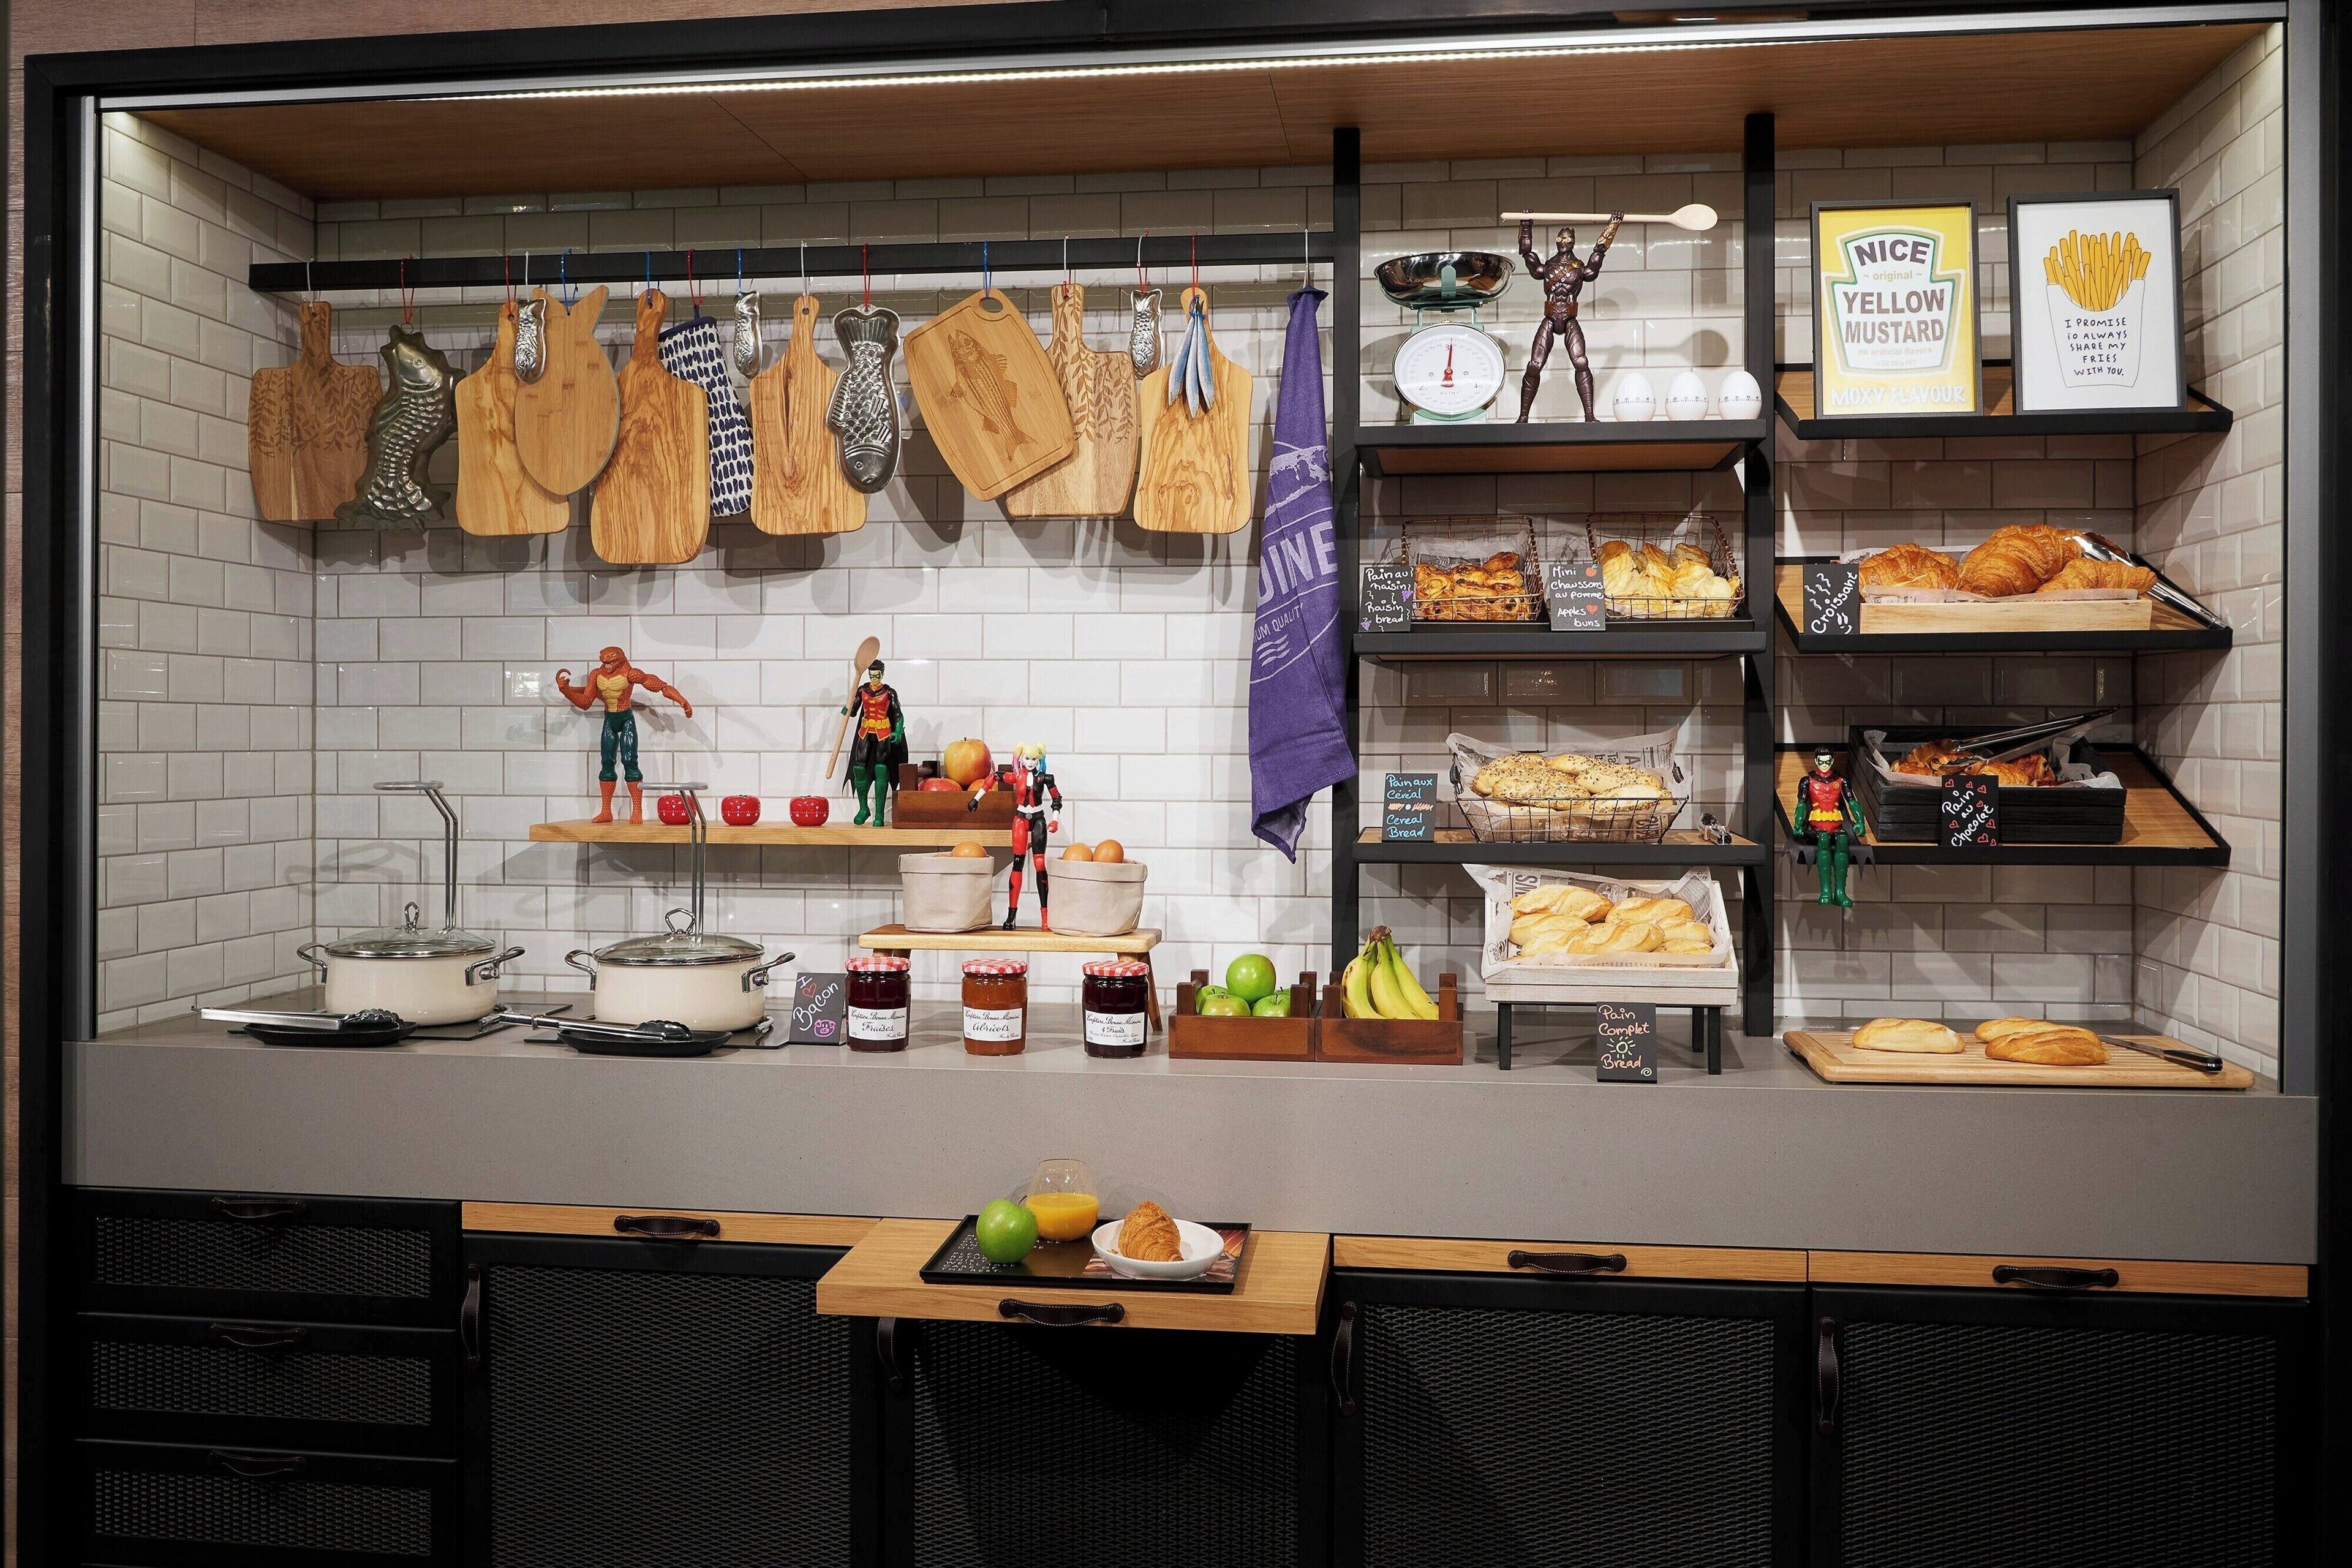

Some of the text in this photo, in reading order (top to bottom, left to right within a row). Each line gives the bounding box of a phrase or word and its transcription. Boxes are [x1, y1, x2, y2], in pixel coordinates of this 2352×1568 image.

[1854, 239, 1930, 266] NICE
[1873, 270, 1912, 282] original
[1842, 289, 1944, 314] YELLOW
[2065, 317, 2126, 328] I PROMISE
[1845, 318, 1944, 344] MUSTARD
[2083, 330, 2127, 339] ALWAYS
[1905, 347, 1932, 355] flavors
[2070, 342, 2126, 352] SHARE MY
[2083, 354, 2117, 363] FRIES
[2074, 366, 2124, 376] WITH YOU.
[1831, 385, 1967, 406] MOXY FLAVOUR
[1366, 568, 1393, 581] Pain
[1553, 565, 1576, 578] Mini
[1365, 600, 1403, 612] Raisin
[1811, 571, 1858, 633] Croissant
[1557, 606, 1586, 617] Apples
[1376, 614, 1403, 624] bread
[1574, 618, 1600, 627] buns
[1386, 774, 1412, 787] Pain
[1942, 790, 1974, 815] Pain
[1961, 805, 1973, 818] au
[1386, 812, 1422, 825] Cereal
[1951, 804, 1994, 846] Chocolat
[1387, 826, 1425, 838] Bread
[797, 976, 813, 989] I
[793, 982, 839, 1031] Bacon
[1598, 1005, 1635, 1020] Pain
[1598, 1022, 1650, 1036] Complet
[1600, 1054, 1642, 1069] Bread
